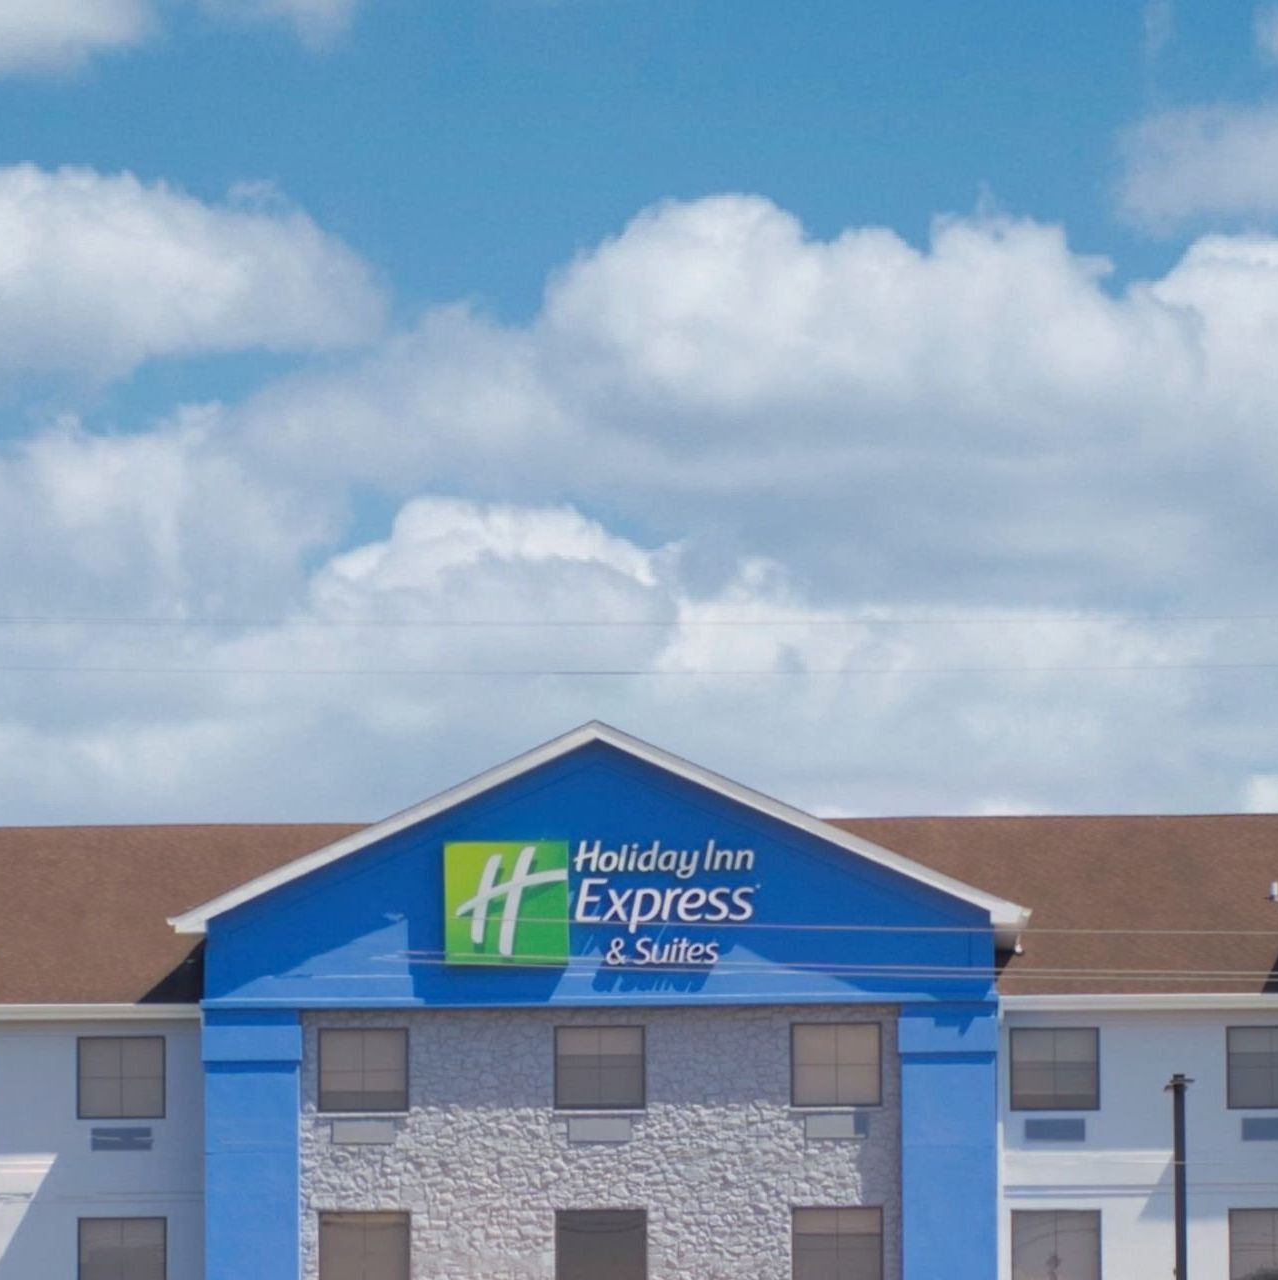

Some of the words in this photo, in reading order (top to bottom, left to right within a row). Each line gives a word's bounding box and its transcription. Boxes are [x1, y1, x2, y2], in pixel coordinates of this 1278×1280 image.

[574, 840, 699, 879] Holiday
[704, 839, 755, 871] Inn
[575, 878, 755, 934] Express
[606, 937, 625, 965] &
[634, 937, 720, 965] Suites
